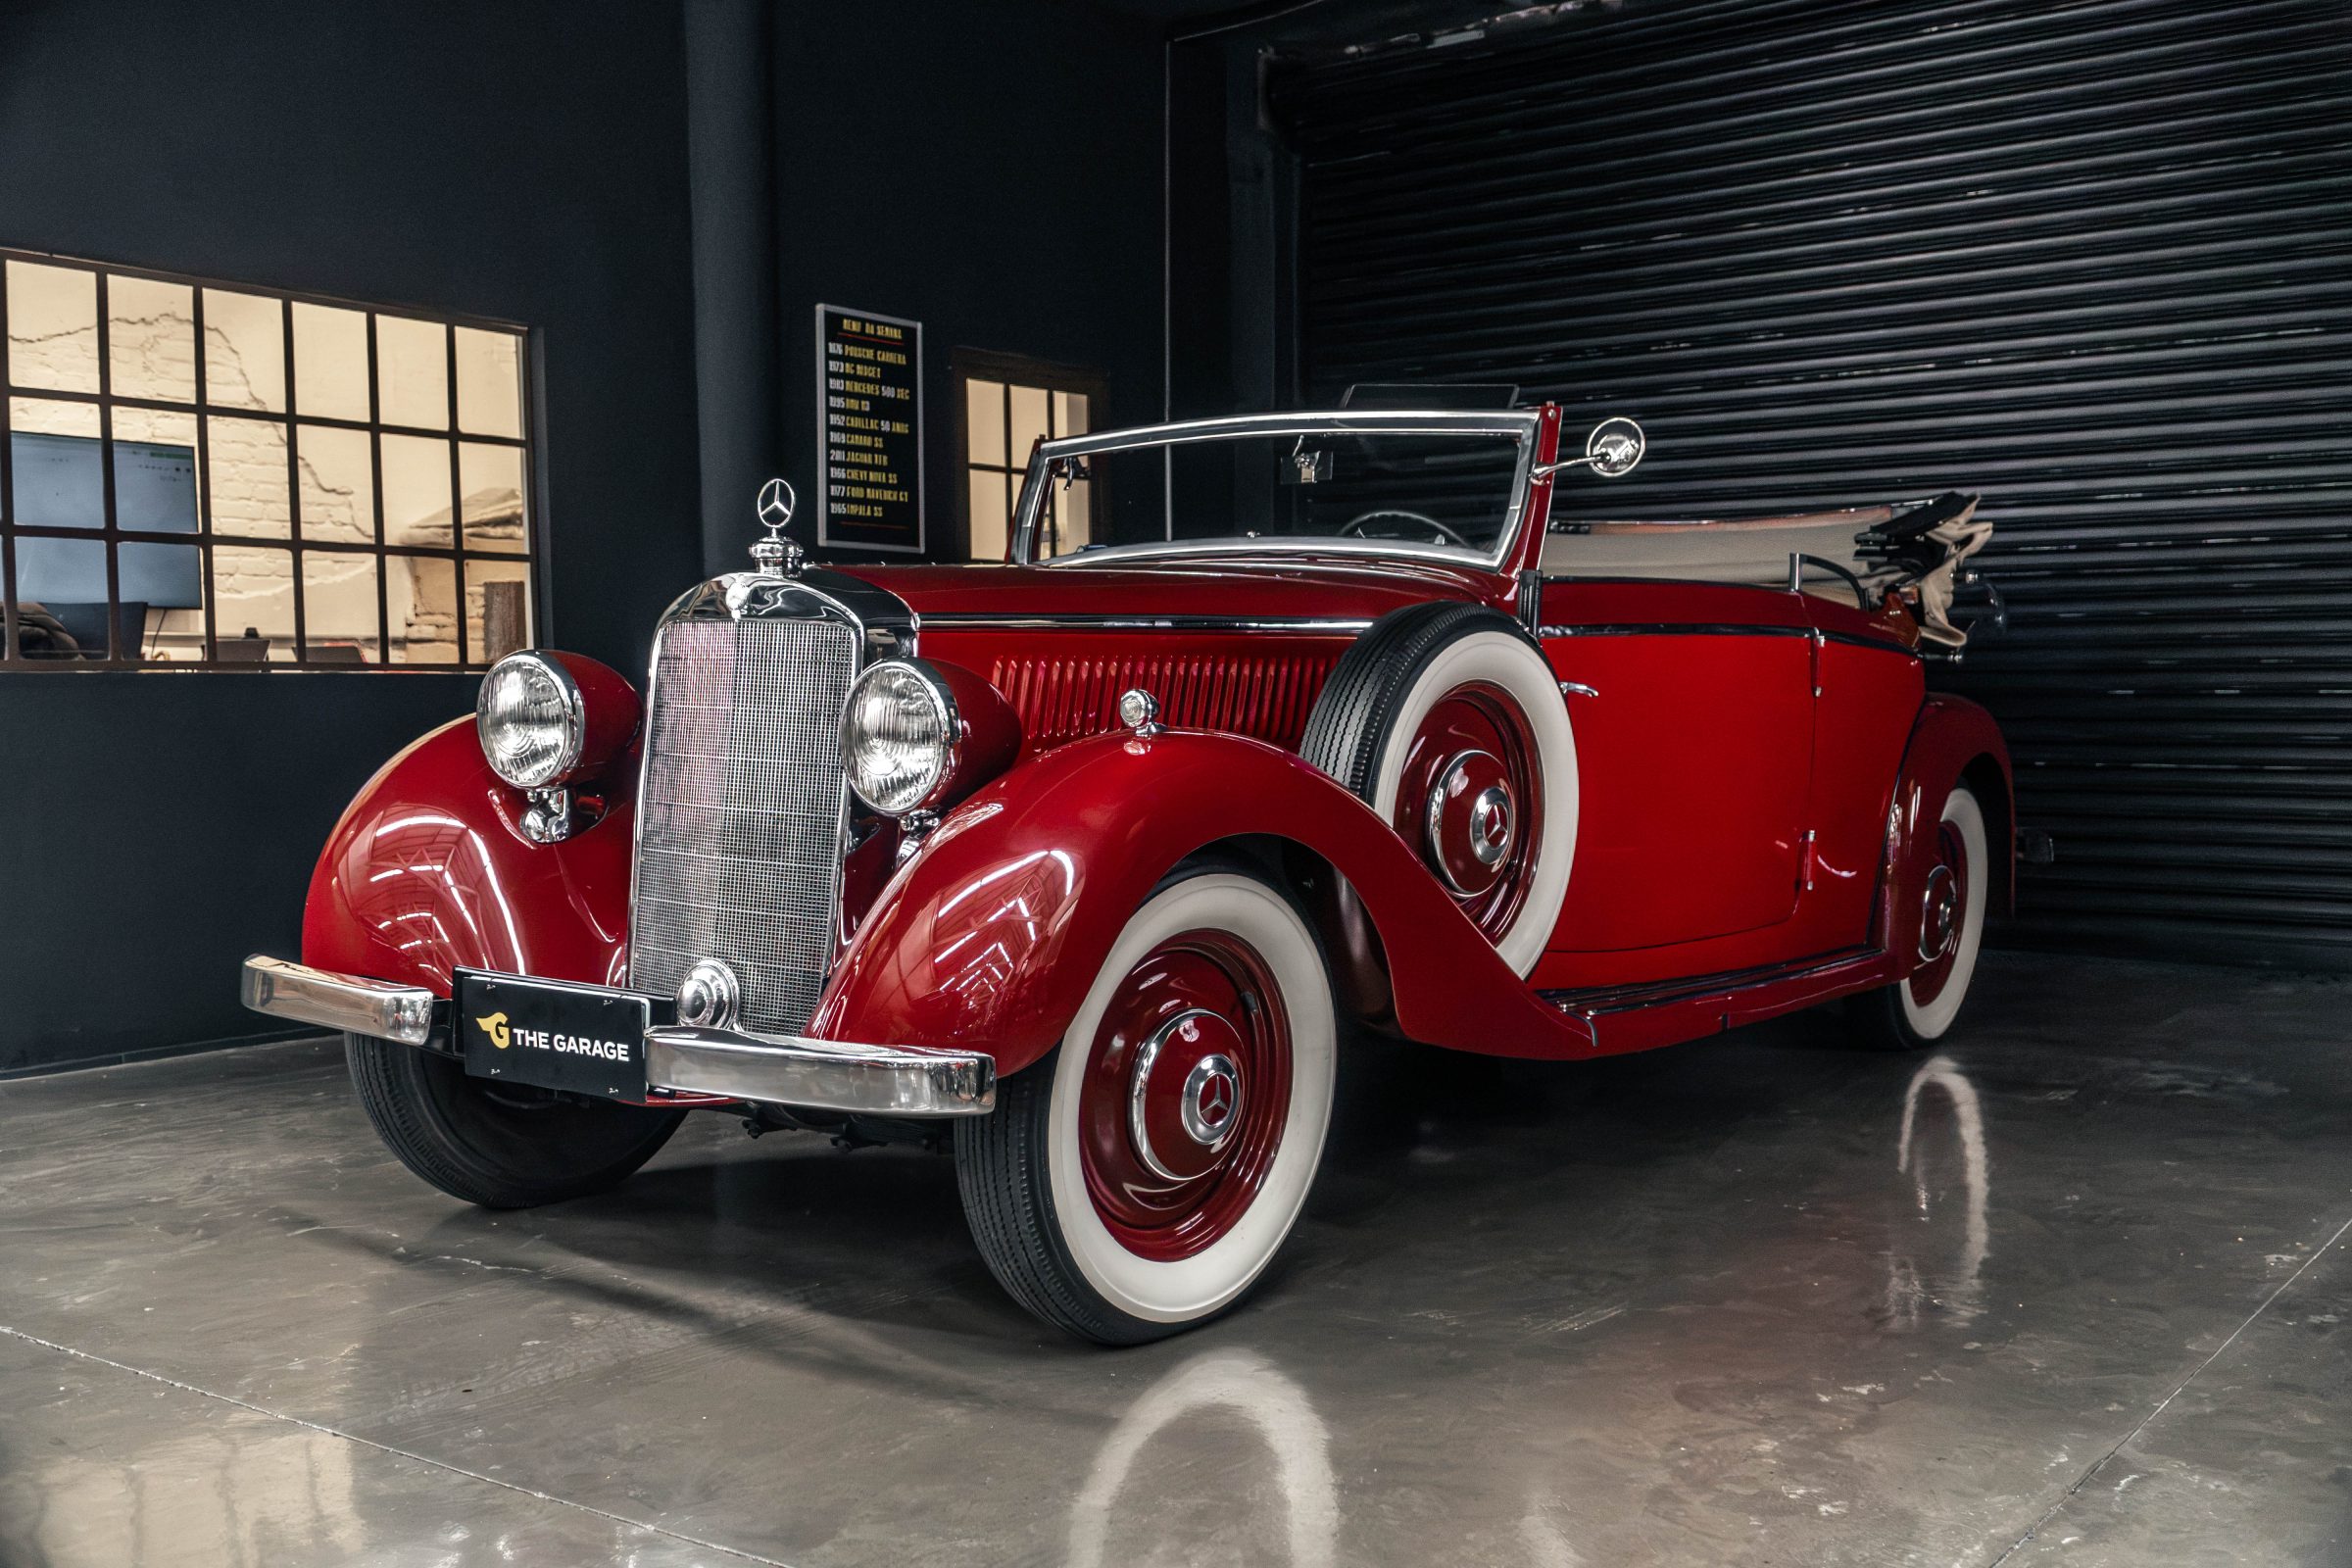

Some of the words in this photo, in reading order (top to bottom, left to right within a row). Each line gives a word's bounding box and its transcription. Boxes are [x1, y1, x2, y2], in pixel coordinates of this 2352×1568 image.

[845, 344, 874, 360] PORSCHE
[877, 350, 906, 366] CARRERA
[846, 380, 880, 396] MERCEDES
[881, 385, 895, 398] 500
[846, 416, 879, 430] CADILLAC
[846, 433, 872, 447] CAMARO
[846, 451, 872, 465] JAGUAR
[847, 468, 867, 481] CHEVY
[869, 470, 886, 483] NOVA
[888, 473, 898, 484] SS
[847, 485, 864, 499] FORD
[866, 487, 898, 502] MAVERICK
[847, 503, 871, 516] IMPALA
[513, 1028, 550, 1050] THE
[553, 1034, 630, 1062] GARAGE
